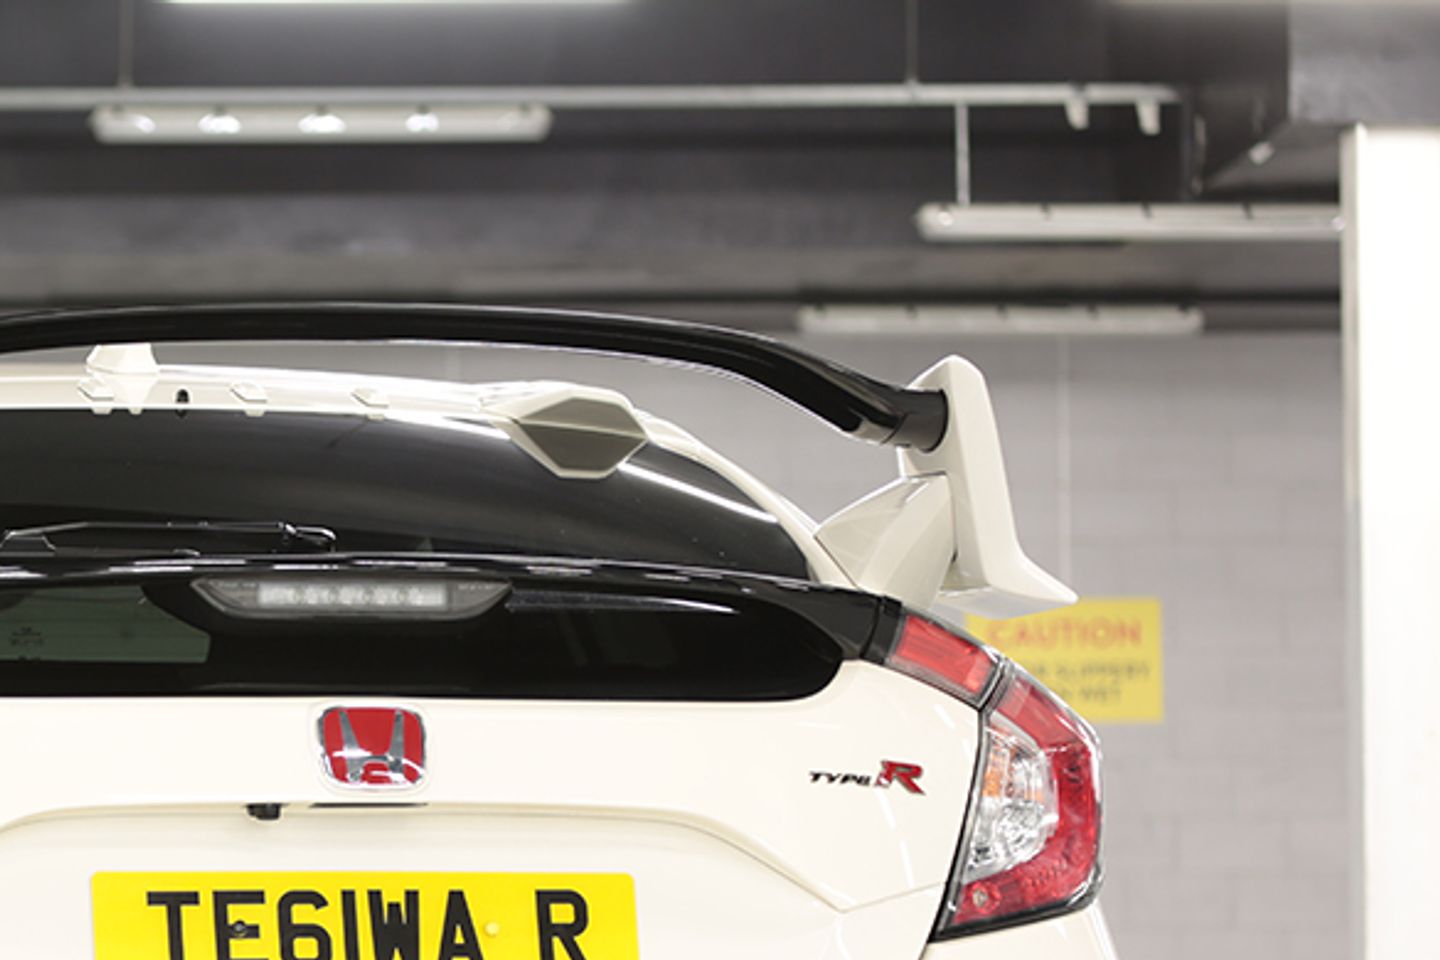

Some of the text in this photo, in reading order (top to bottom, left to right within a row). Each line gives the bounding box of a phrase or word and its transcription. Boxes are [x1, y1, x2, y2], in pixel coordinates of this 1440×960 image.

[987, 618, 1143, 649] CAUTION
[810, 759, 926, 795] TYPE R
